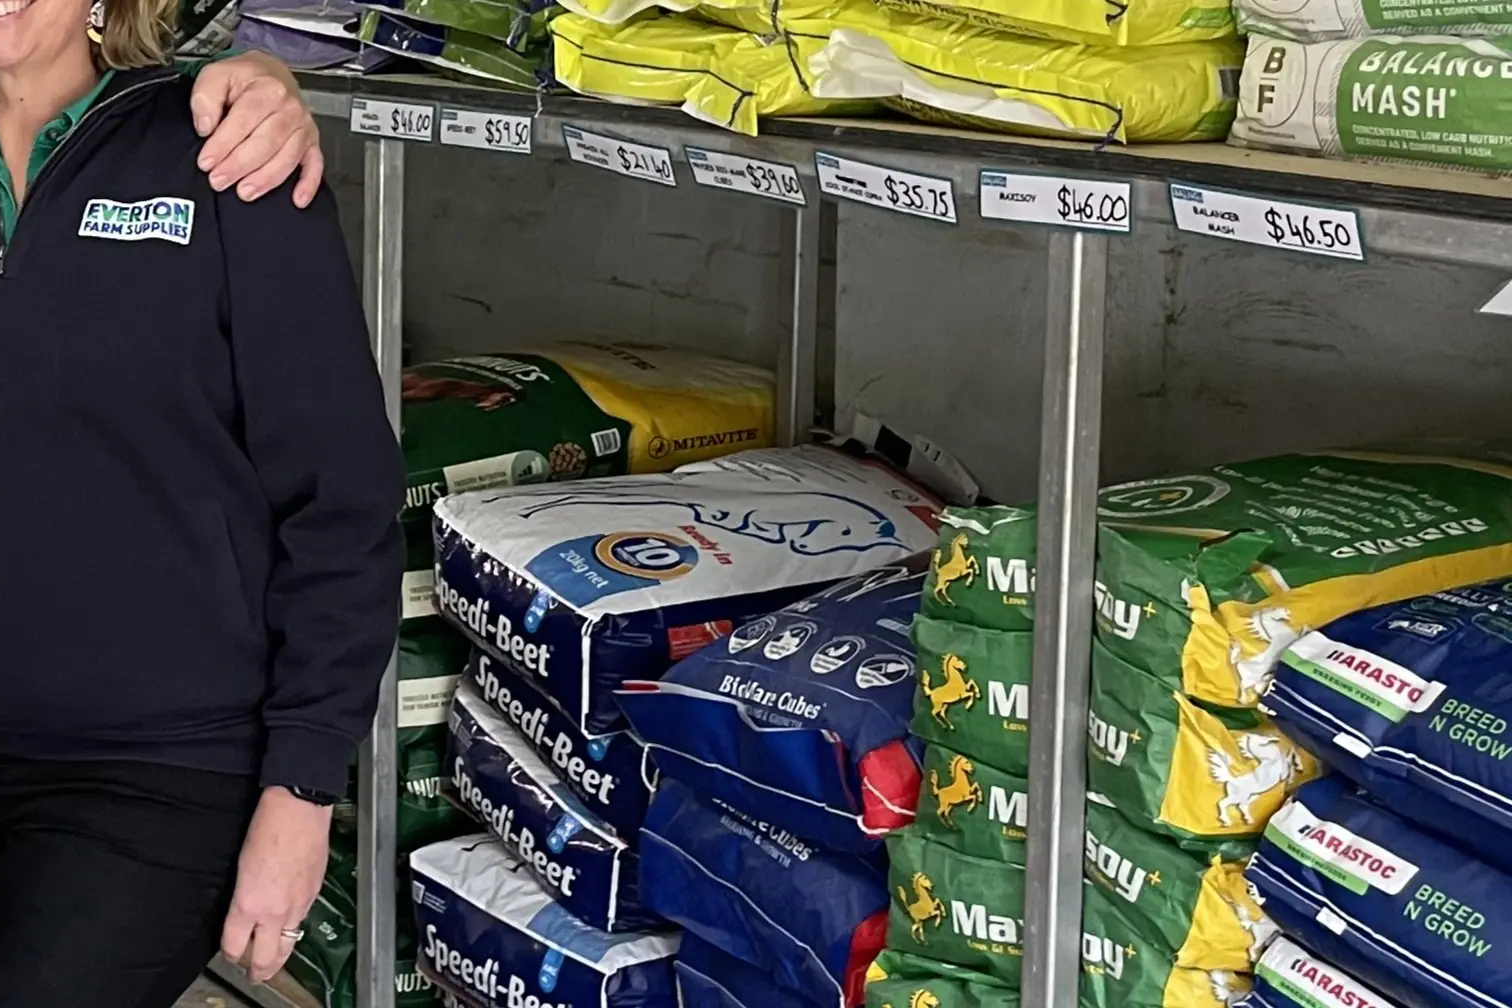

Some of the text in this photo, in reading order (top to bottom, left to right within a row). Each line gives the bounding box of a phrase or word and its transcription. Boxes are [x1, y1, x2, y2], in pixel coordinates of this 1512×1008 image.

[1264, 45, 1287, 75] B
[1257, 83, 1276, 114] F
[1352, 81, 1447, 119] MASH
[87, 200, 191, 225] EVERTON
[884, 174, 948, 217] $35.75
[1057, 184, 1128, 222] $46.00
[83, 220, 188, 240] FARM SUPPLIES
[1264, 206, 1351, 249] $46.50
[672, 428, 759, 453] MITAVITE
[624, 538, 680, 567] 10
[777, 691, 822, 720] Cubes
[1440, 698, 1507, 735] BREED
[475, 652, 616, 805] Speedi-Beet
[1428, 715, 1512, 761] N GROW
[452, 755, 576, 897] Speedi-Beet
[1414, 883, 1487, 931] BREED
[1403, 900, 1494, 959] N GROW
